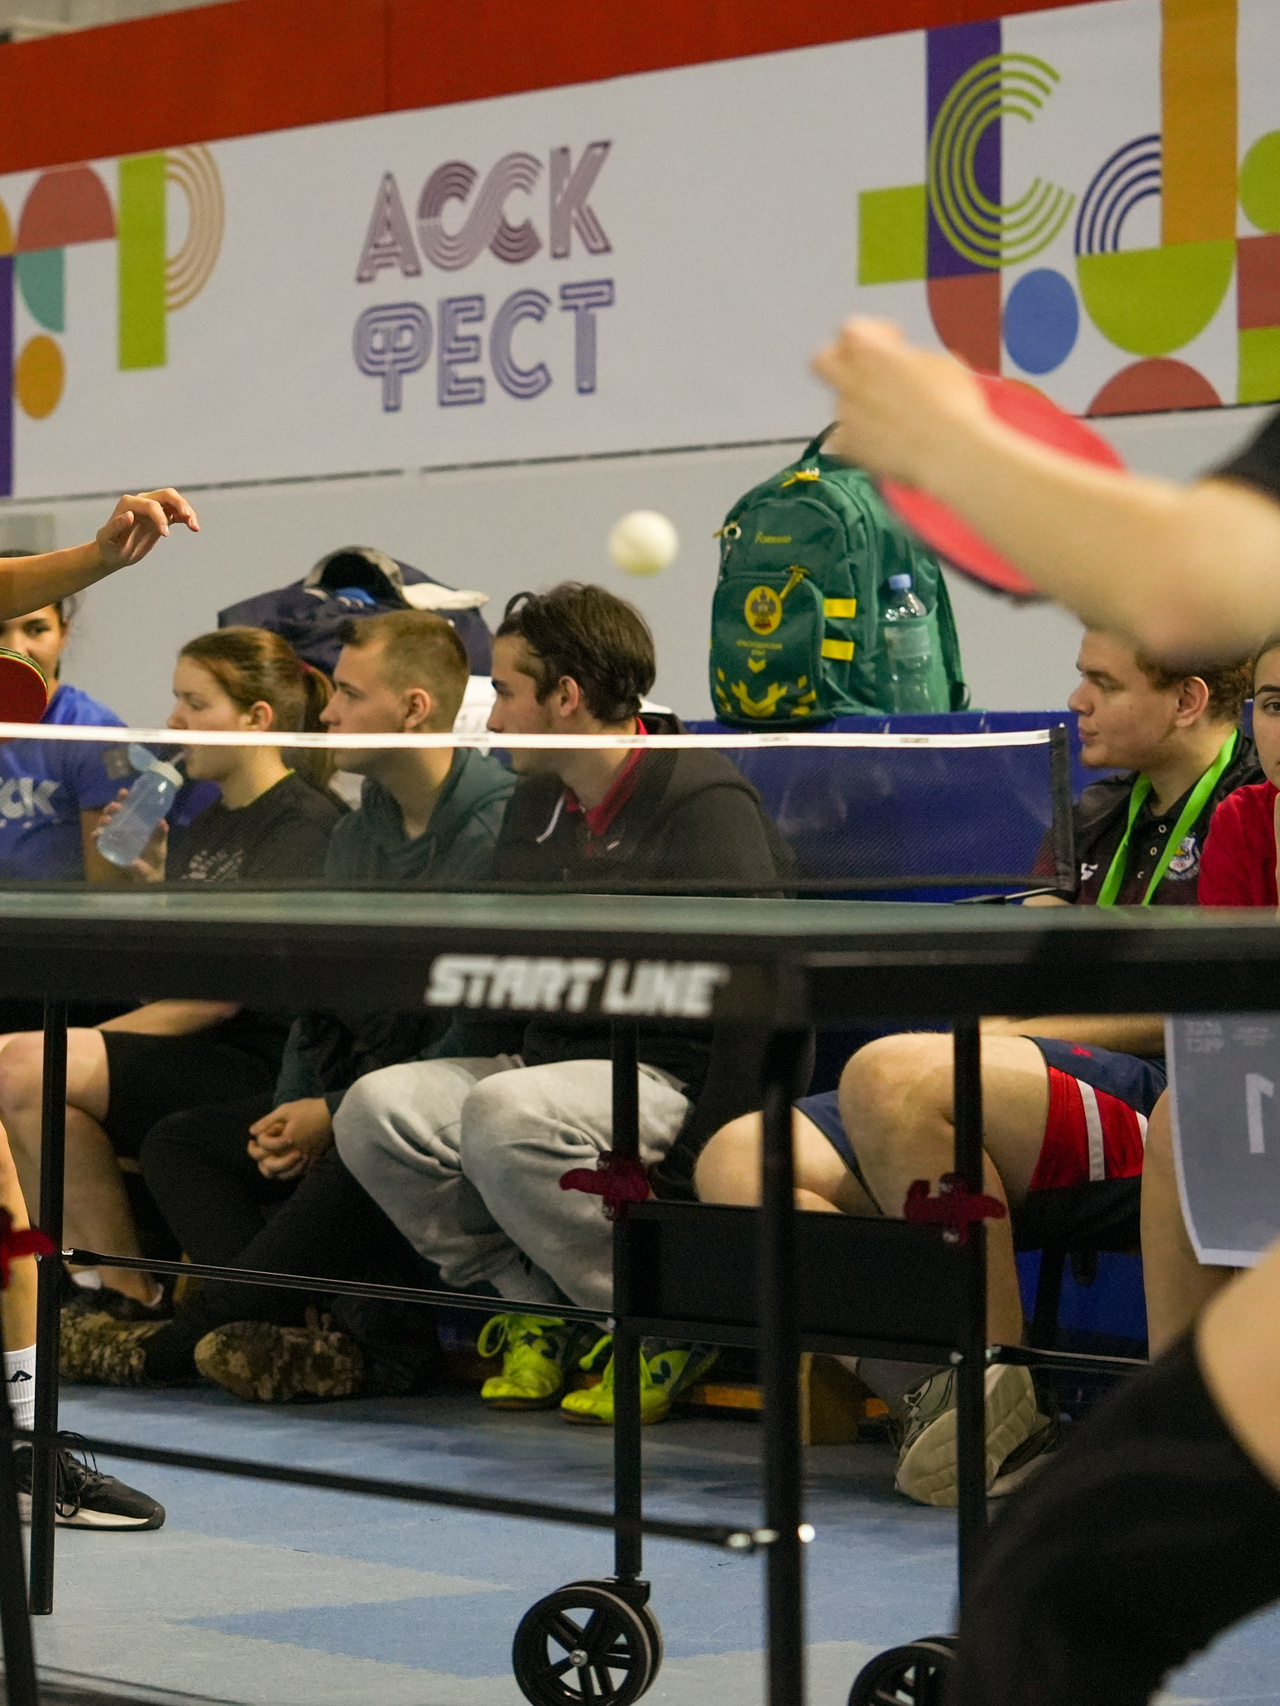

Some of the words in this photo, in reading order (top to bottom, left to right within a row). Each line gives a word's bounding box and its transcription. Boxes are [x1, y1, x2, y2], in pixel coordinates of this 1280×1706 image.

[355, 139, 612, 284] АССК
[352, 279, 614, 412] ФЕСТ
[424, 953, 605, 1014] START
[601, 958, 726, 1019] LINE
